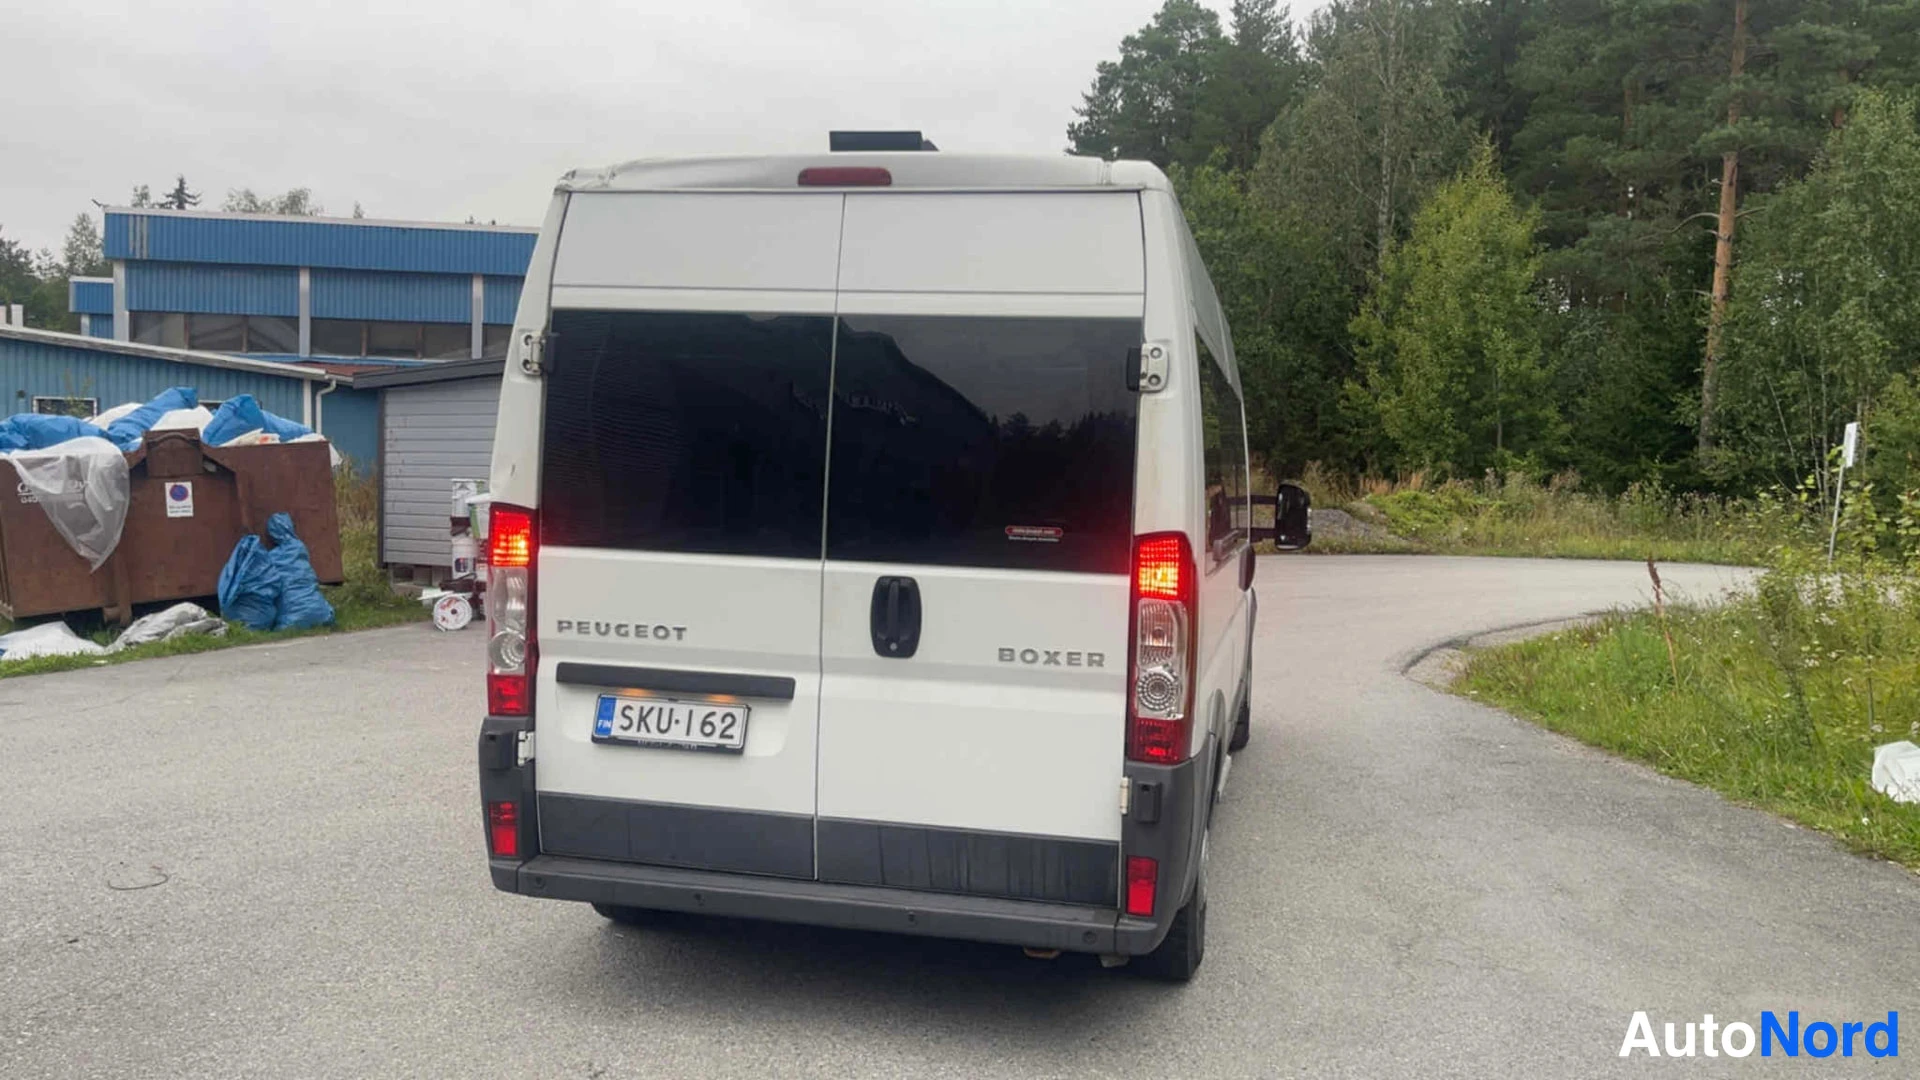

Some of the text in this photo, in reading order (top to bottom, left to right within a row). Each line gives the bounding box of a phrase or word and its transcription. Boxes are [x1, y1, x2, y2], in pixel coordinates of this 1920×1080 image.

[556, 619, 687, 641] PEUGEOT
[998, 647, 1105, 668] BOXER
[597, 719, 611, 729] FIN
